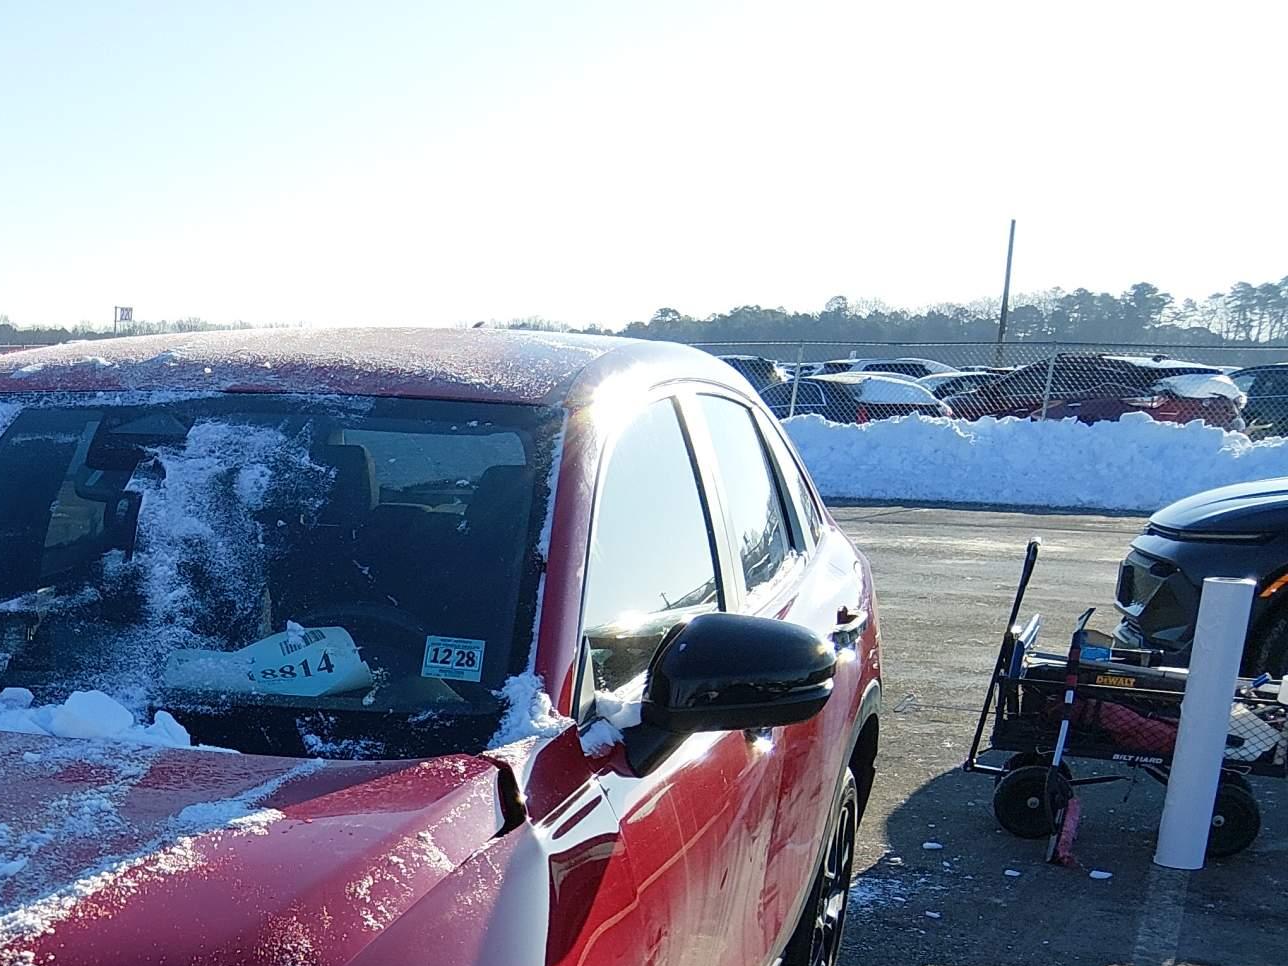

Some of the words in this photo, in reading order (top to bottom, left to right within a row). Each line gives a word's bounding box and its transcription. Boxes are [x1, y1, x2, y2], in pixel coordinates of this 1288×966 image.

[247, 648, 335, 680] 8814
[430, 647, 452, 664] 12
[455, 651, 476, 667] 28
